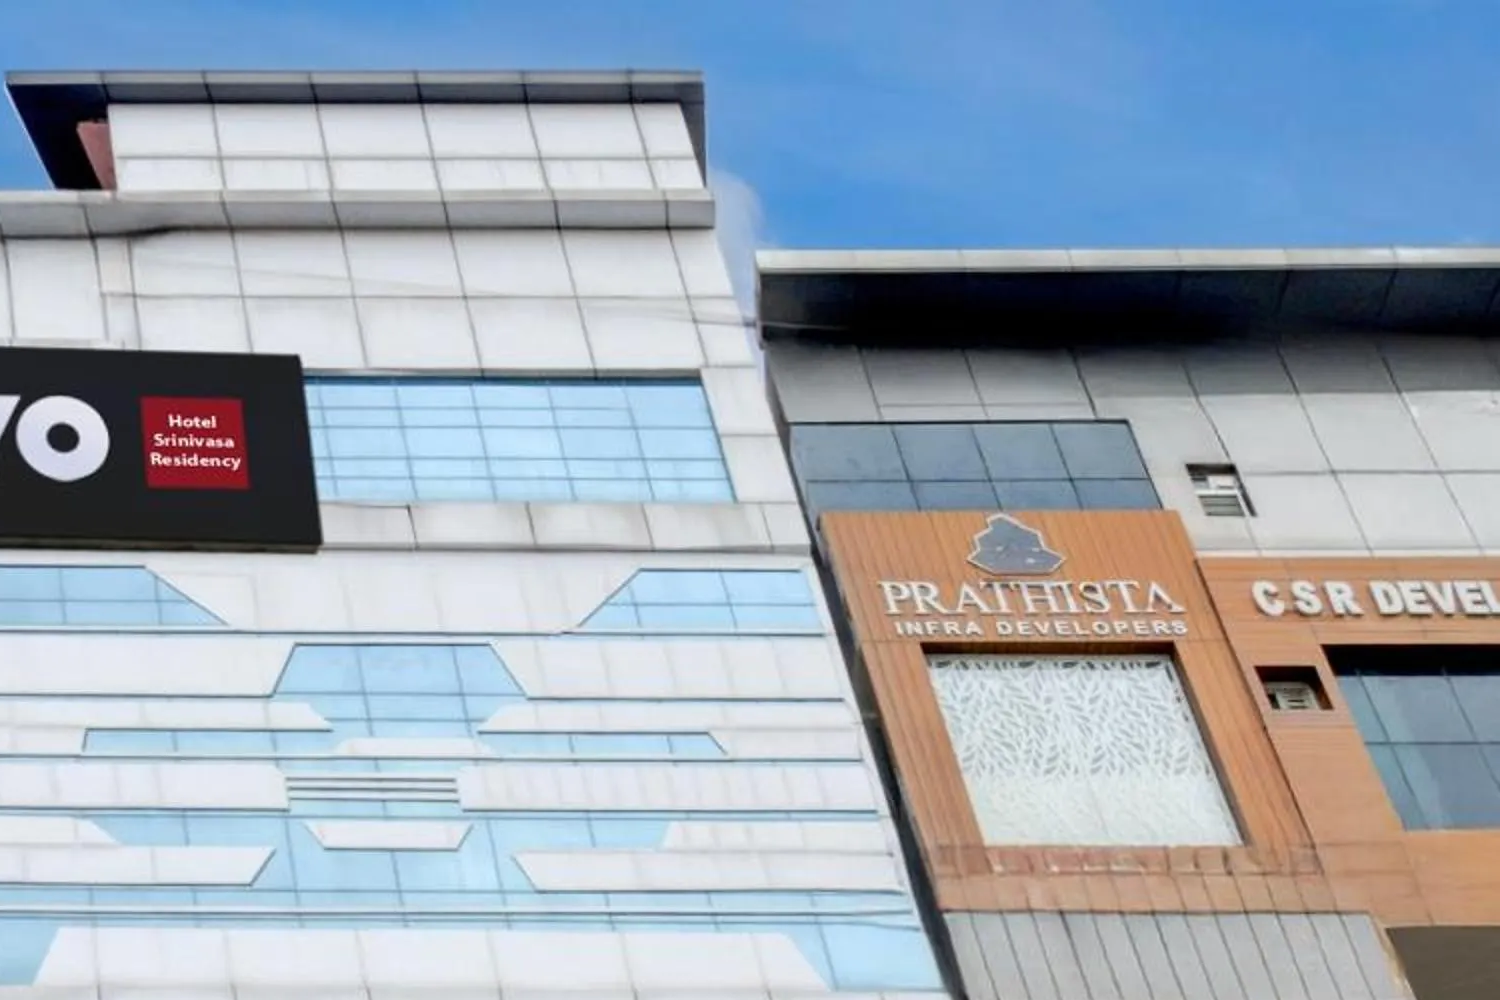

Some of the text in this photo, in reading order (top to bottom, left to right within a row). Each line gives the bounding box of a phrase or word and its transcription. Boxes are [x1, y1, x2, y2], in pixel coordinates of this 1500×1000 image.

[168, 414, 217, 428] Hotel
[153, 433, 235, 448] Srinivasa
[150, 452, 241, 470] Residency
[878, 580, 1187, 615] PRATHISTA
[894, 620, 1189, 637] INFRA DEVELOPERS
